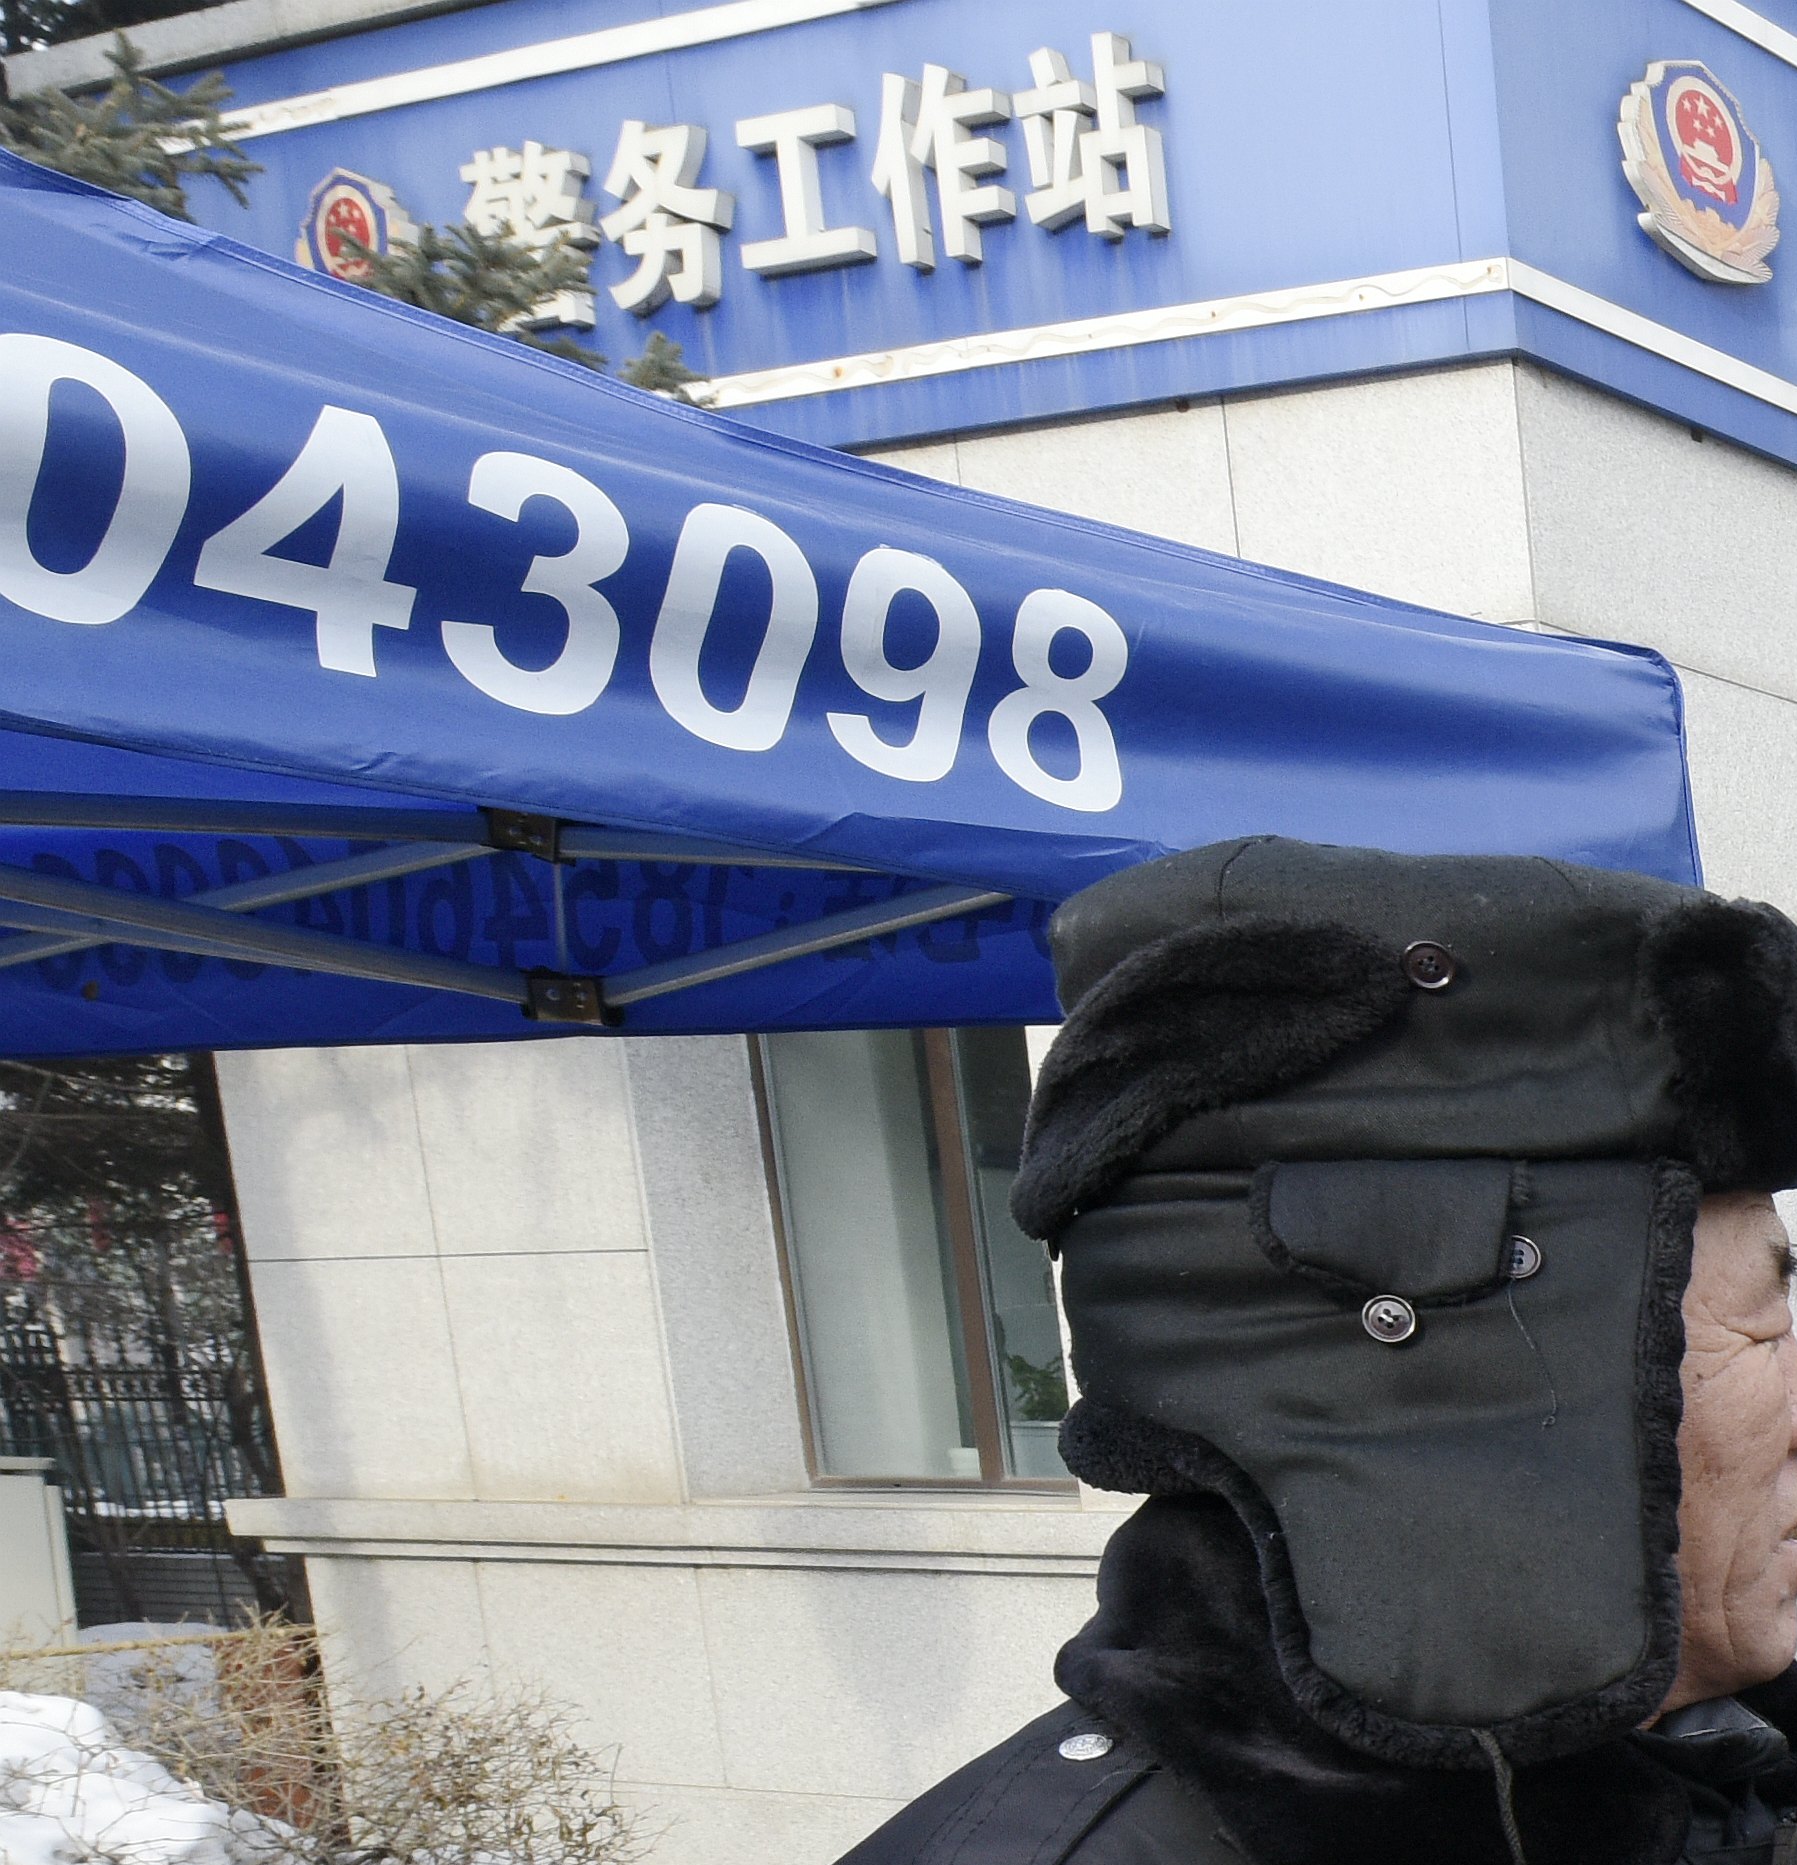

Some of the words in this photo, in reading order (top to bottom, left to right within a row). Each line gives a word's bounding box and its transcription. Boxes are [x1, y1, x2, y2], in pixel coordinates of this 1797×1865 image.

[459, 31, 1173, 331] 警务工作站
[0, 332, 1129, 813] 043098
